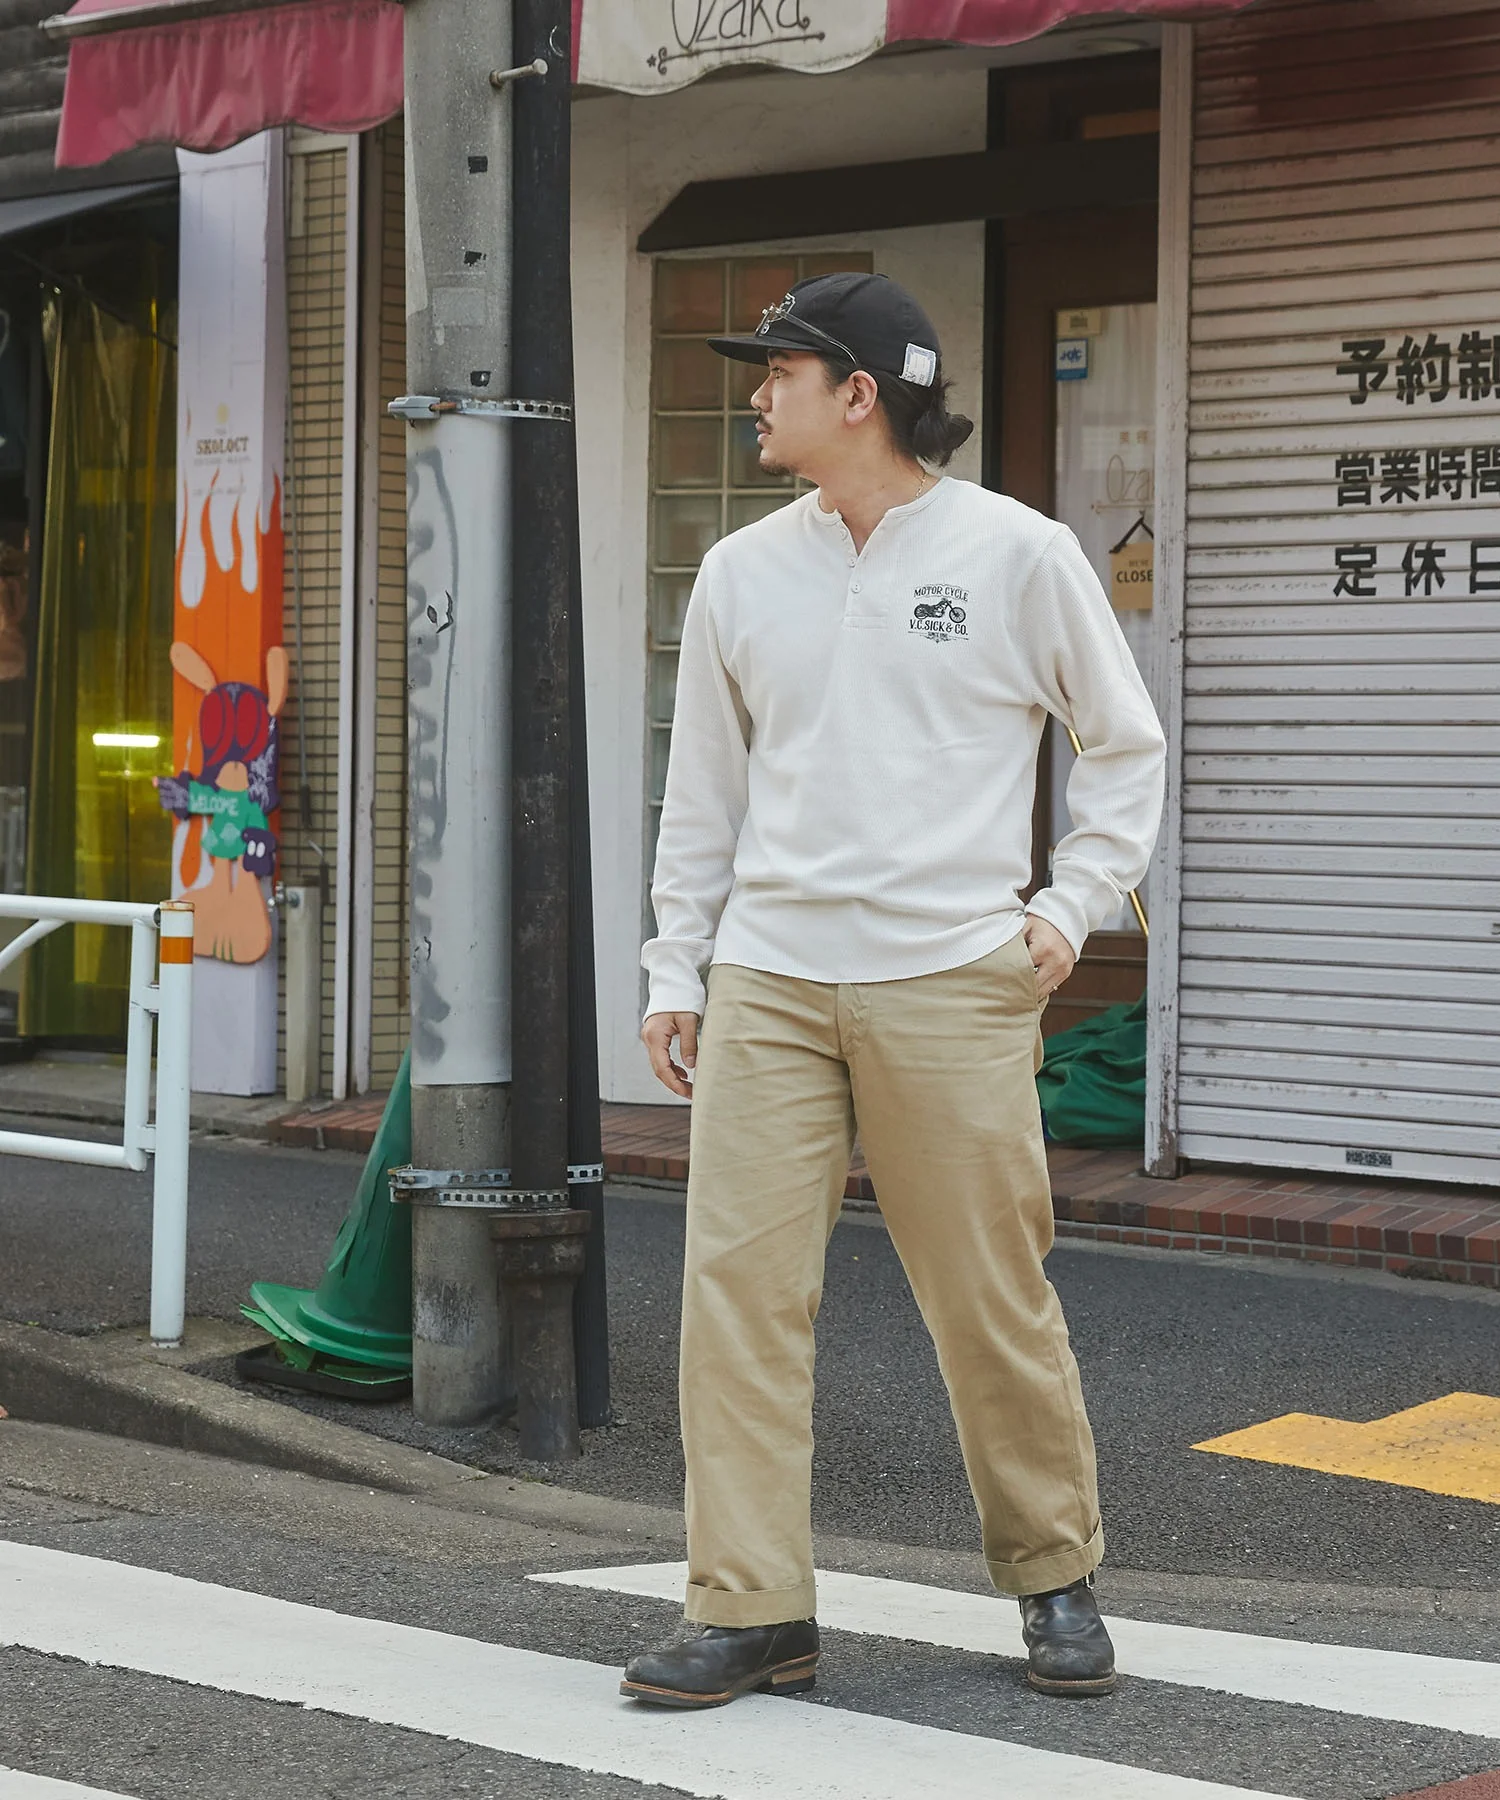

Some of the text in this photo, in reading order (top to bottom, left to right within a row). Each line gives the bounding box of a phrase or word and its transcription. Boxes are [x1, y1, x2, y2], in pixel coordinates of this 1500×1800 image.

[1336, 330, 1500, 405] 予約制
[1106, 454, 1154, 503] Oza
[1335, 447, 1500, 507] 営業時間
[914, 586, 969, 602] MOTOR CYCLE
[1333, 540, 1500, 597] 定休日
[189, 793, 238, 816] WELCOME
